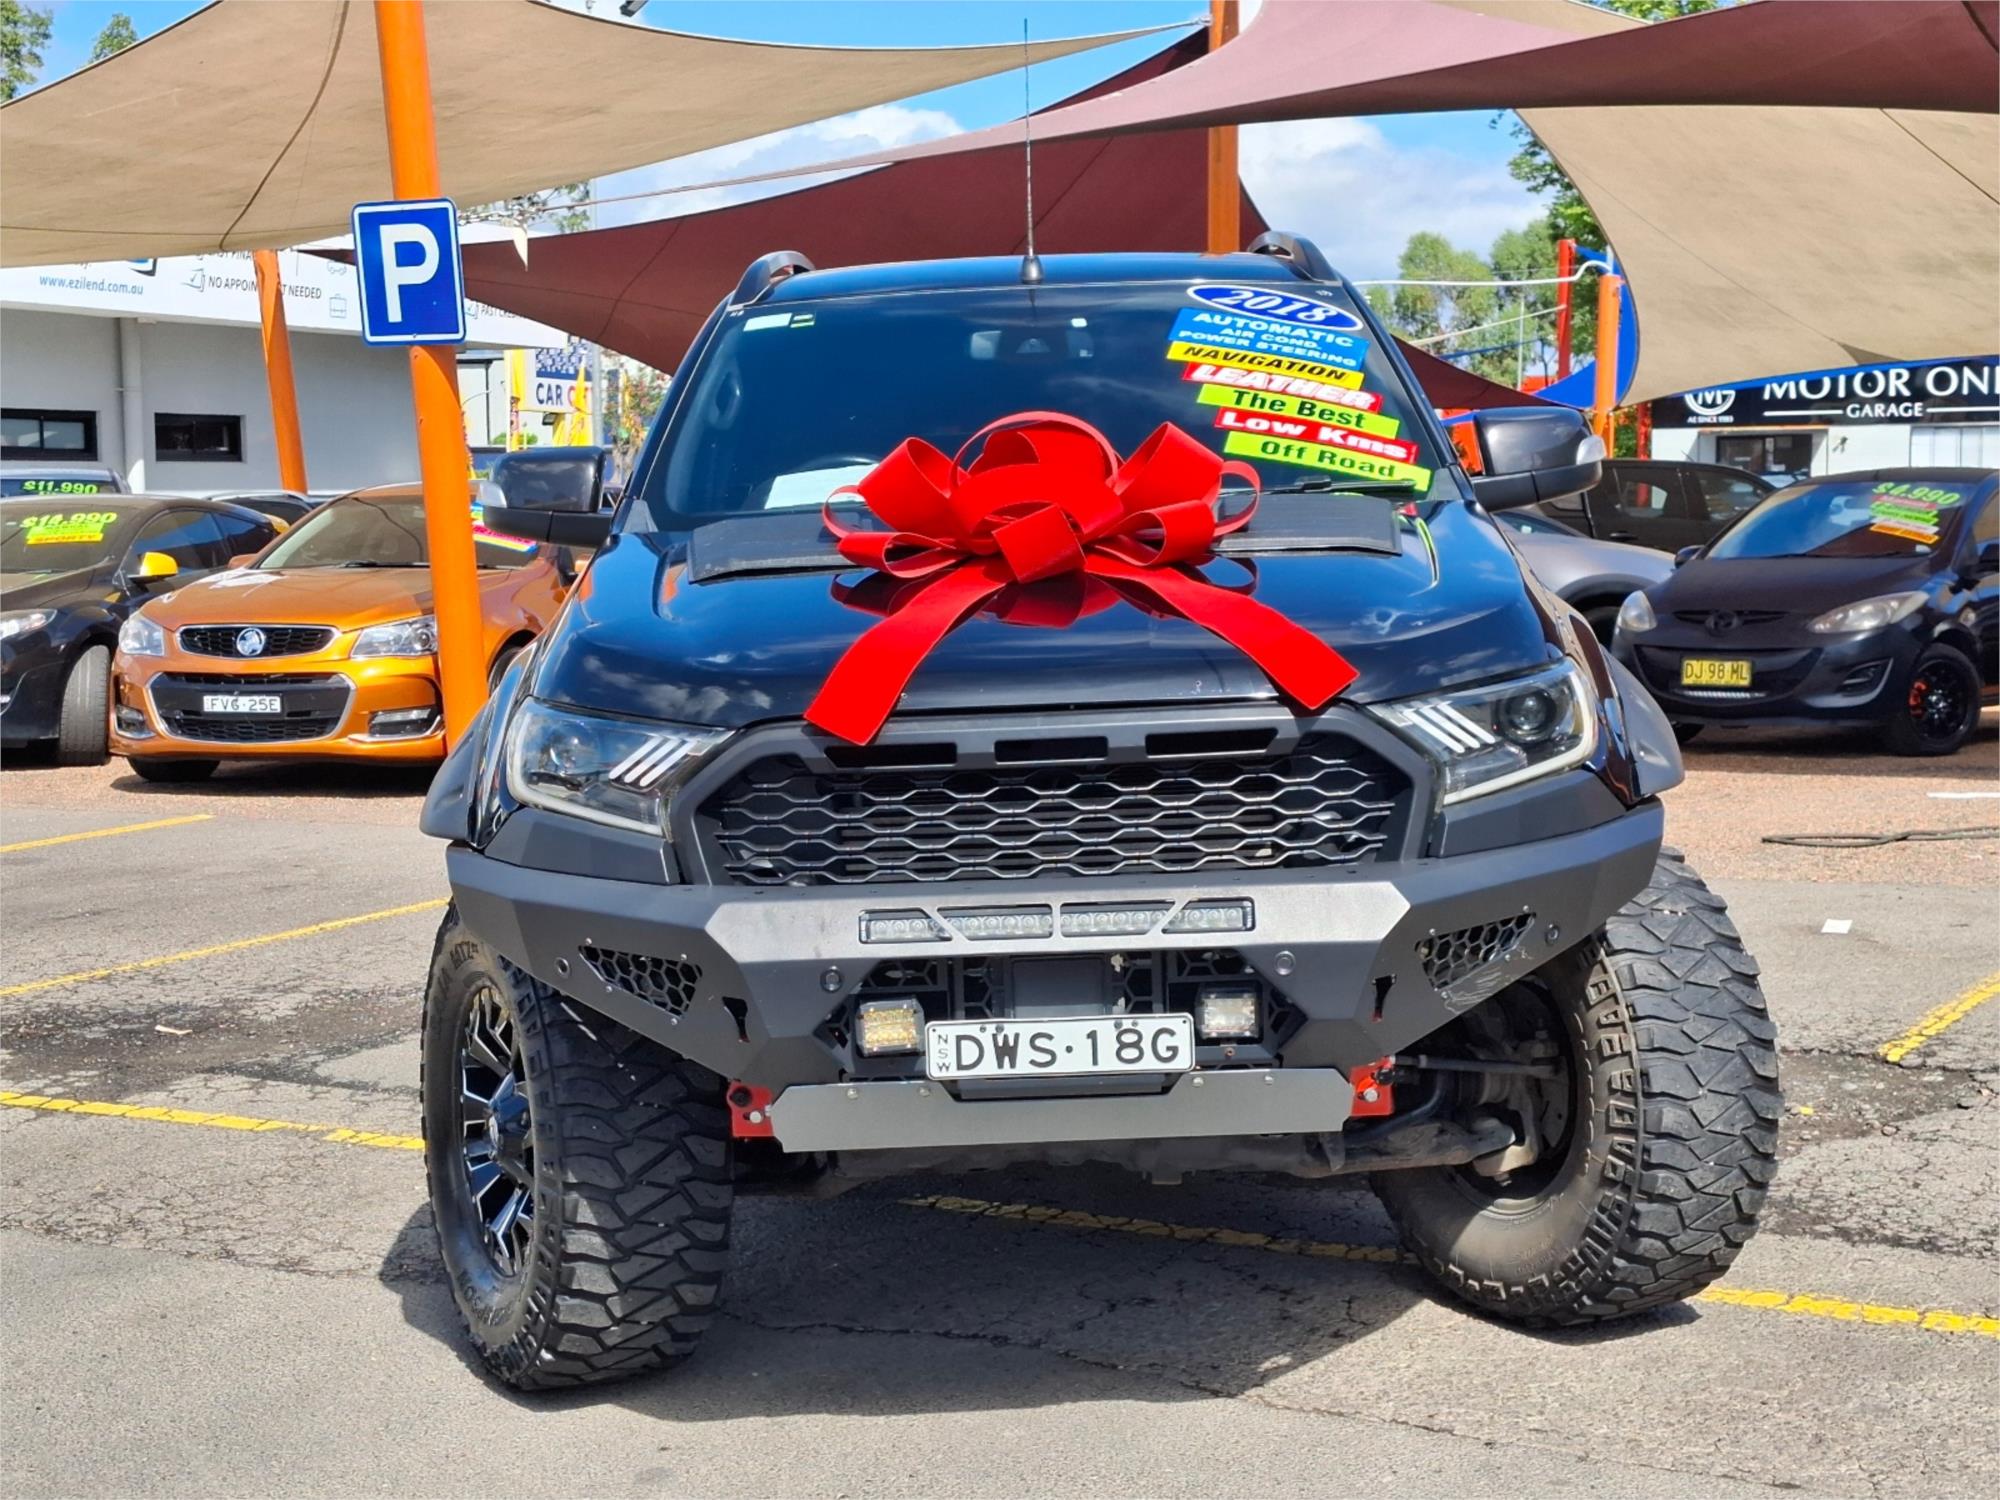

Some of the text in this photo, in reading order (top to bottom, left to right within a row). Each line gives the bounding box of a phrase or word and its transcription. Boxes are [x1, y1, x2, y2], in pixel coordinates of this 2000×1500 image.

[39, 275, 144, 295] www.ezilend.com.au
[208, 276, 222, 288] NO
[288, 287, 322, 299] NEEDED
[379, 222, 440, 323] P
[1211, 290, 1338, 323] 2018
[1193, 313, 1354, 348] AUTOMATIC
[1220, 327, 1322, 350] AIR COND.
[1178, 330, 1358, 368] POWER STEERING
[1184, 346, 1347, 380] NAVIGATION
[536, 382, 563, 406] CAR
[1190, 364, 1376, 410] LEATHER
[1763, 369, 1912, 400] MOTOR
[1233, 389, 1367, 429] The Best
[1846, 402, 1924, 418] GARAGE
[1222, 411, 1409, 459] Low Kms
[1261, 440, 1396, 478] Off Road
[936, 1034, 952, 1073] NSW
